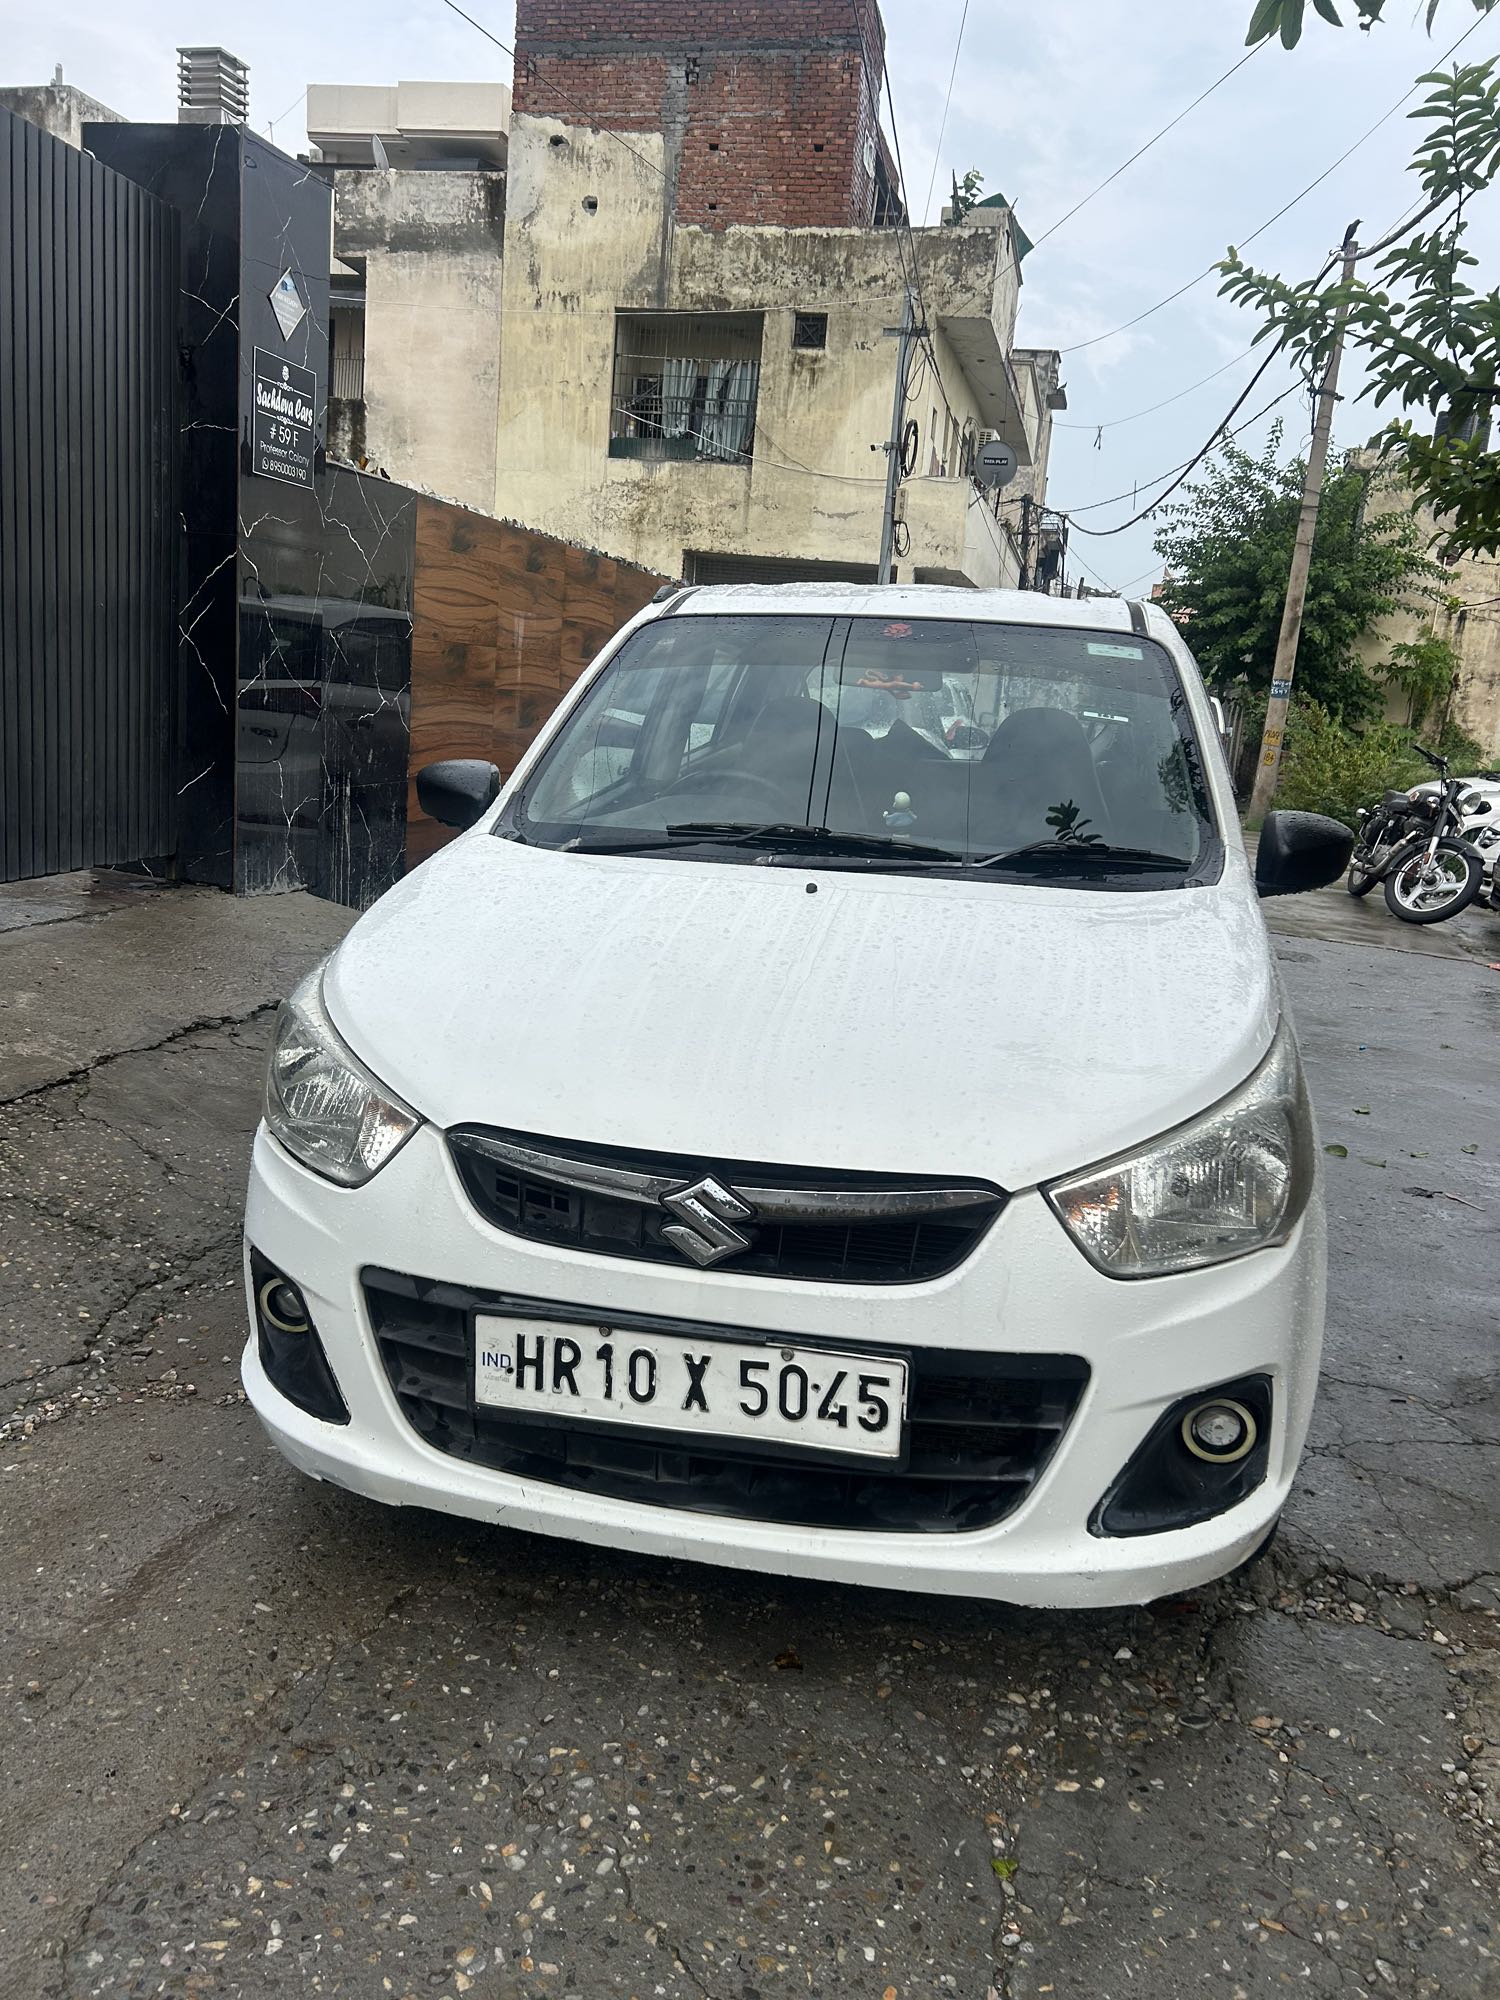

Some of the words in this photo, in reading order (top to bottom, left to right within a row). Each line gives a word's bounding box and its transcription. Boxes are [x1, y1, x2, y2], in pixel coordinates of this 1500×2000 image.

[257, 382, 293, 417] Sachdeva
[294, 398, 313, 426] Cars
[278, 426, 292, 445] 59
[293, 430, 299, 448] F
[260, 440, 288, 458] Professor
[288, 449, 310, 467] Colony
[269, 461, 306, 480] 8950003190
[482, 1351, 511, 1369] IND
[681, 1352, 712, 1412] X
[738, 1360, 890, 1433] 5045
